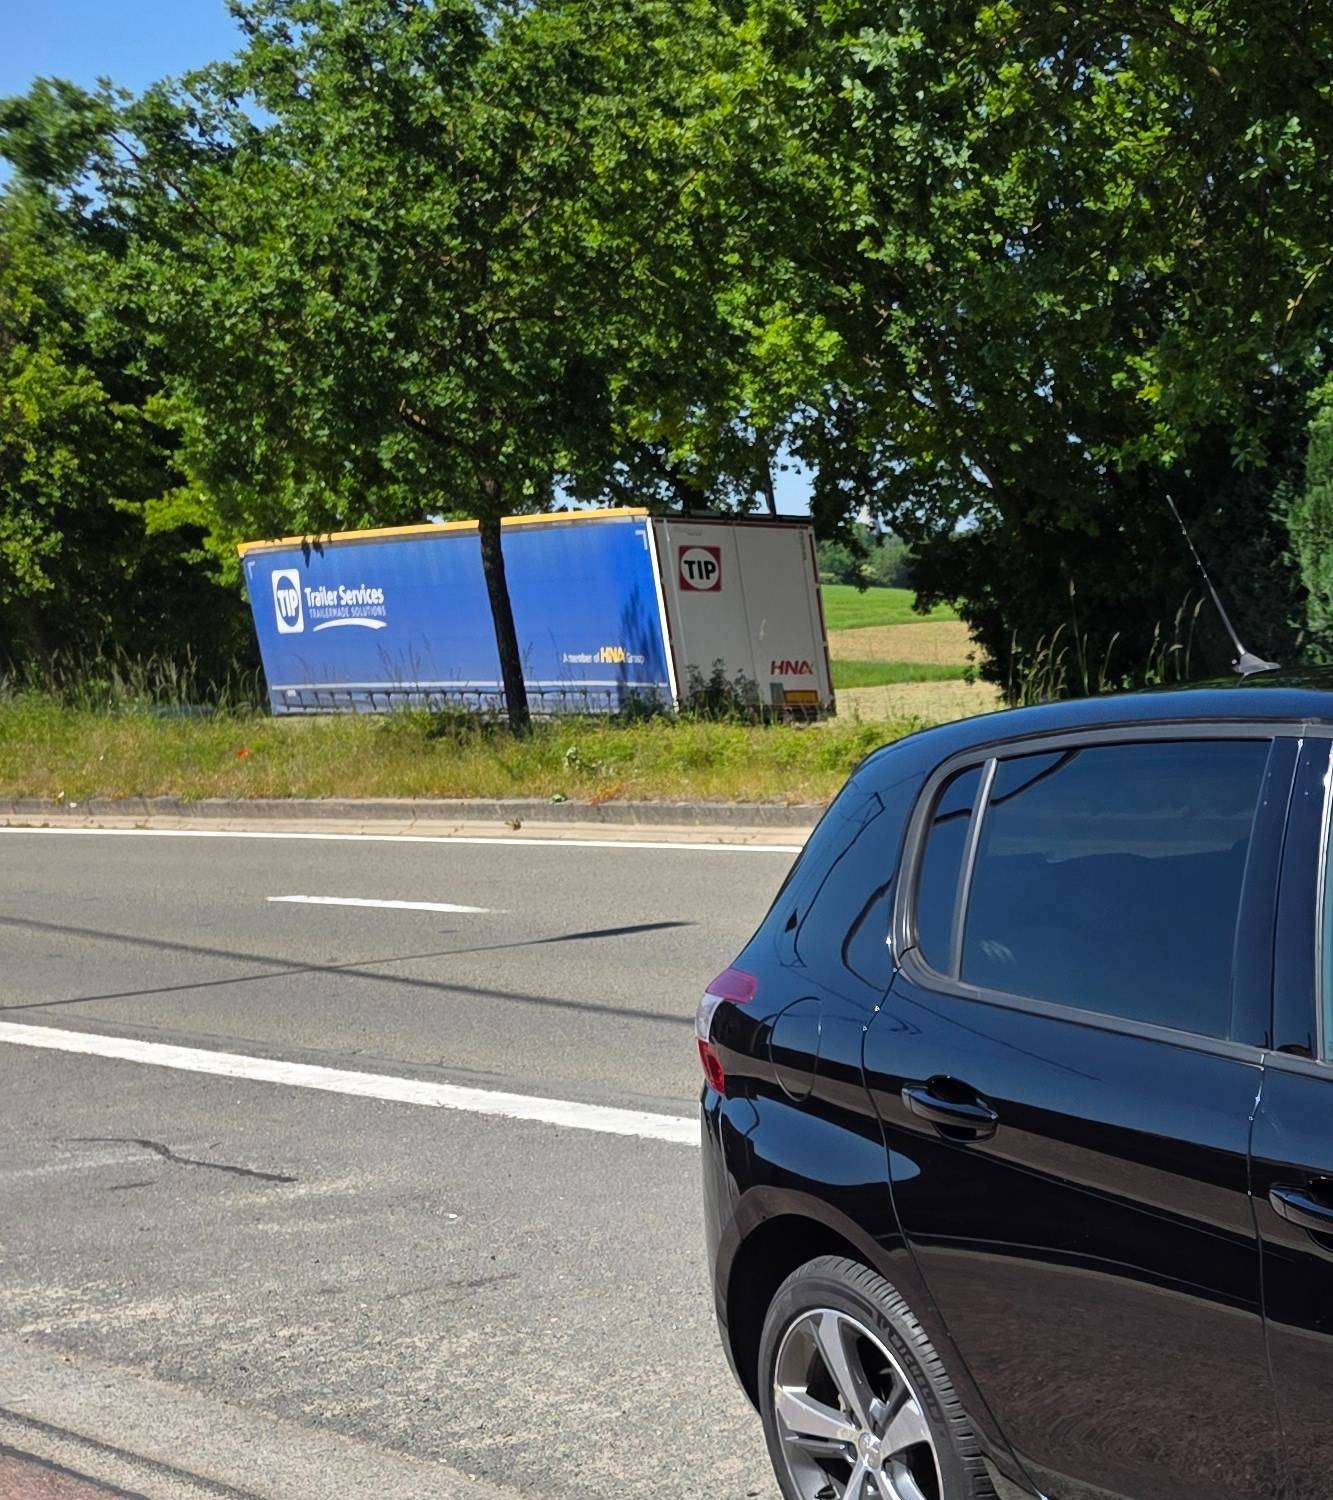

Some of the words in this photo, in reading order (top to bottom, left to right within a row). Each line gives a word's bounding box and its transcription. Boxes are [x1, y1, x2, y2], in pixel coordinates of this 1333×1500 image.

[684, 559, 716, 580] TIP
[277, 588, 299, 617] TIP
[304, 586, 338, 607] Trailer
[338, 584, 385, 606] Services
[351, 605, 387, 617] SOLUTIONS
[600, 646, 626, 664] HNA
[770, 660, 813, 675] HNA
